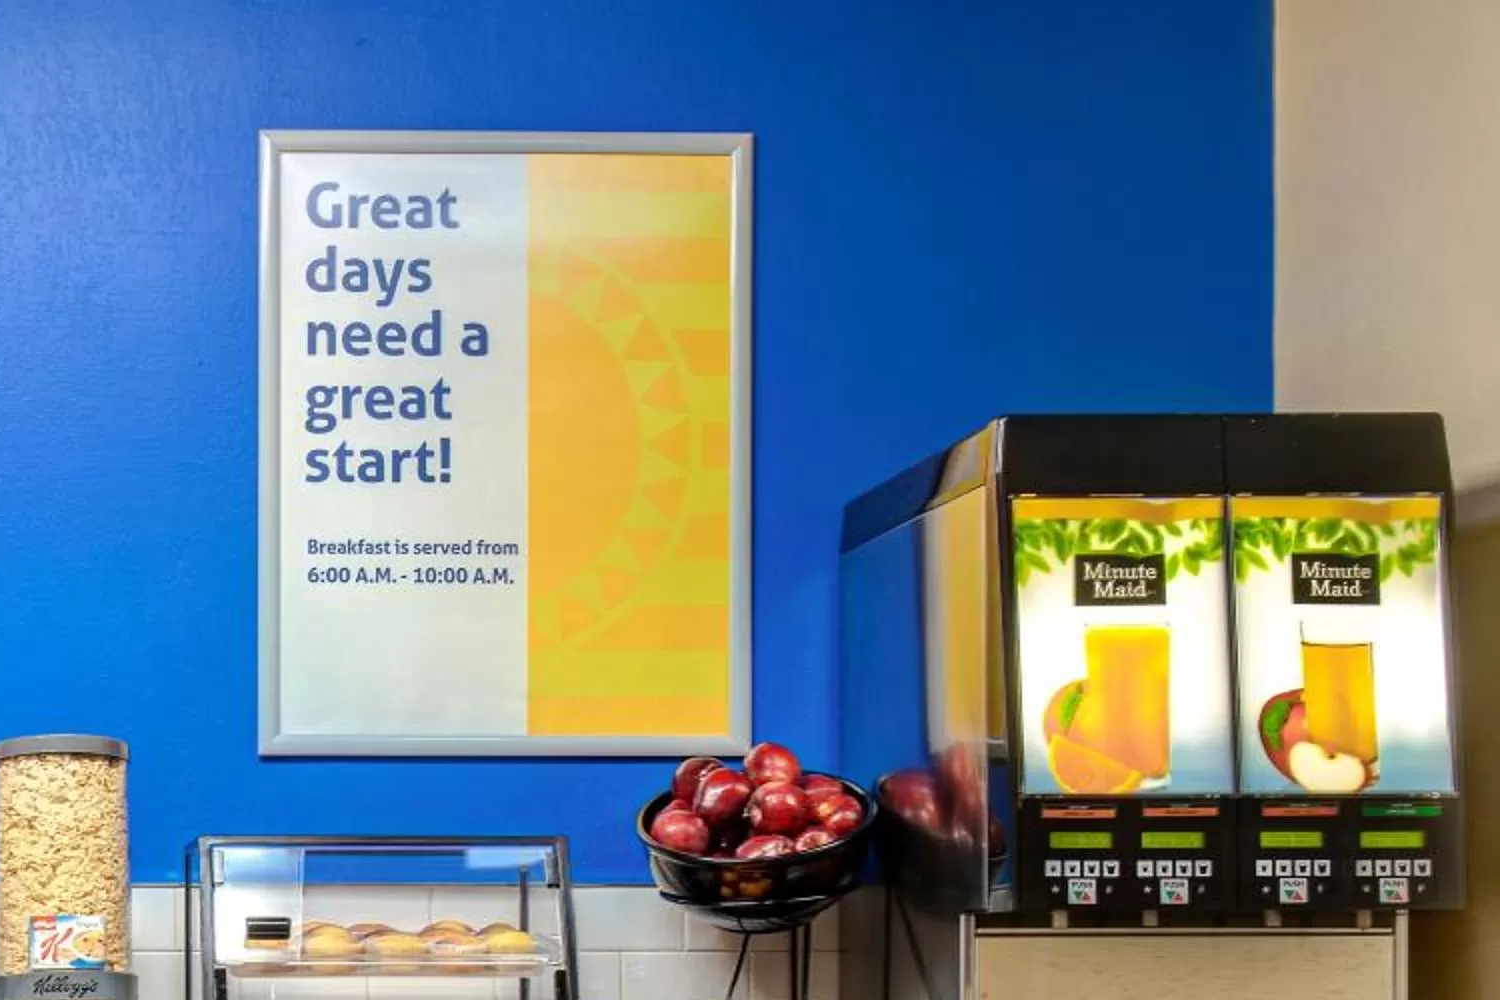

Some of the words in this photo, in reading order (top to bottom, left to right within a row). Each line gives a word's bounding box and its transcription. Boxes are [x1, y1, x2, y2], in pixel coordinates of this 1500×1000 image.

[306, 181, 460, 229] Great
[305, 246, 433, 307] days
[306, 309, 443, 357] need
[460, 322, 489, 357] a
[304, 377, 453, 435] great
[305, 437, 452, 483] start!
[307, 538, 391, 556] Breakfast
[394, 538, 409, 556] is
[413, 540, 472, 556] served
[477, 540, 520, 556] from
[307, 567, 351, 585] 6:00
[355, 567, 397, 585] A.M.
[413, 567, 469, 585] 10:00
[472, 567, 515, 585] A.M.
[1083, 562, 1157, 580] Minute
[1300, 561, 1372, 579] Minute
[1093, 580, 1148, 599] Maid
[1310, 579, 1363, 597] Maid
